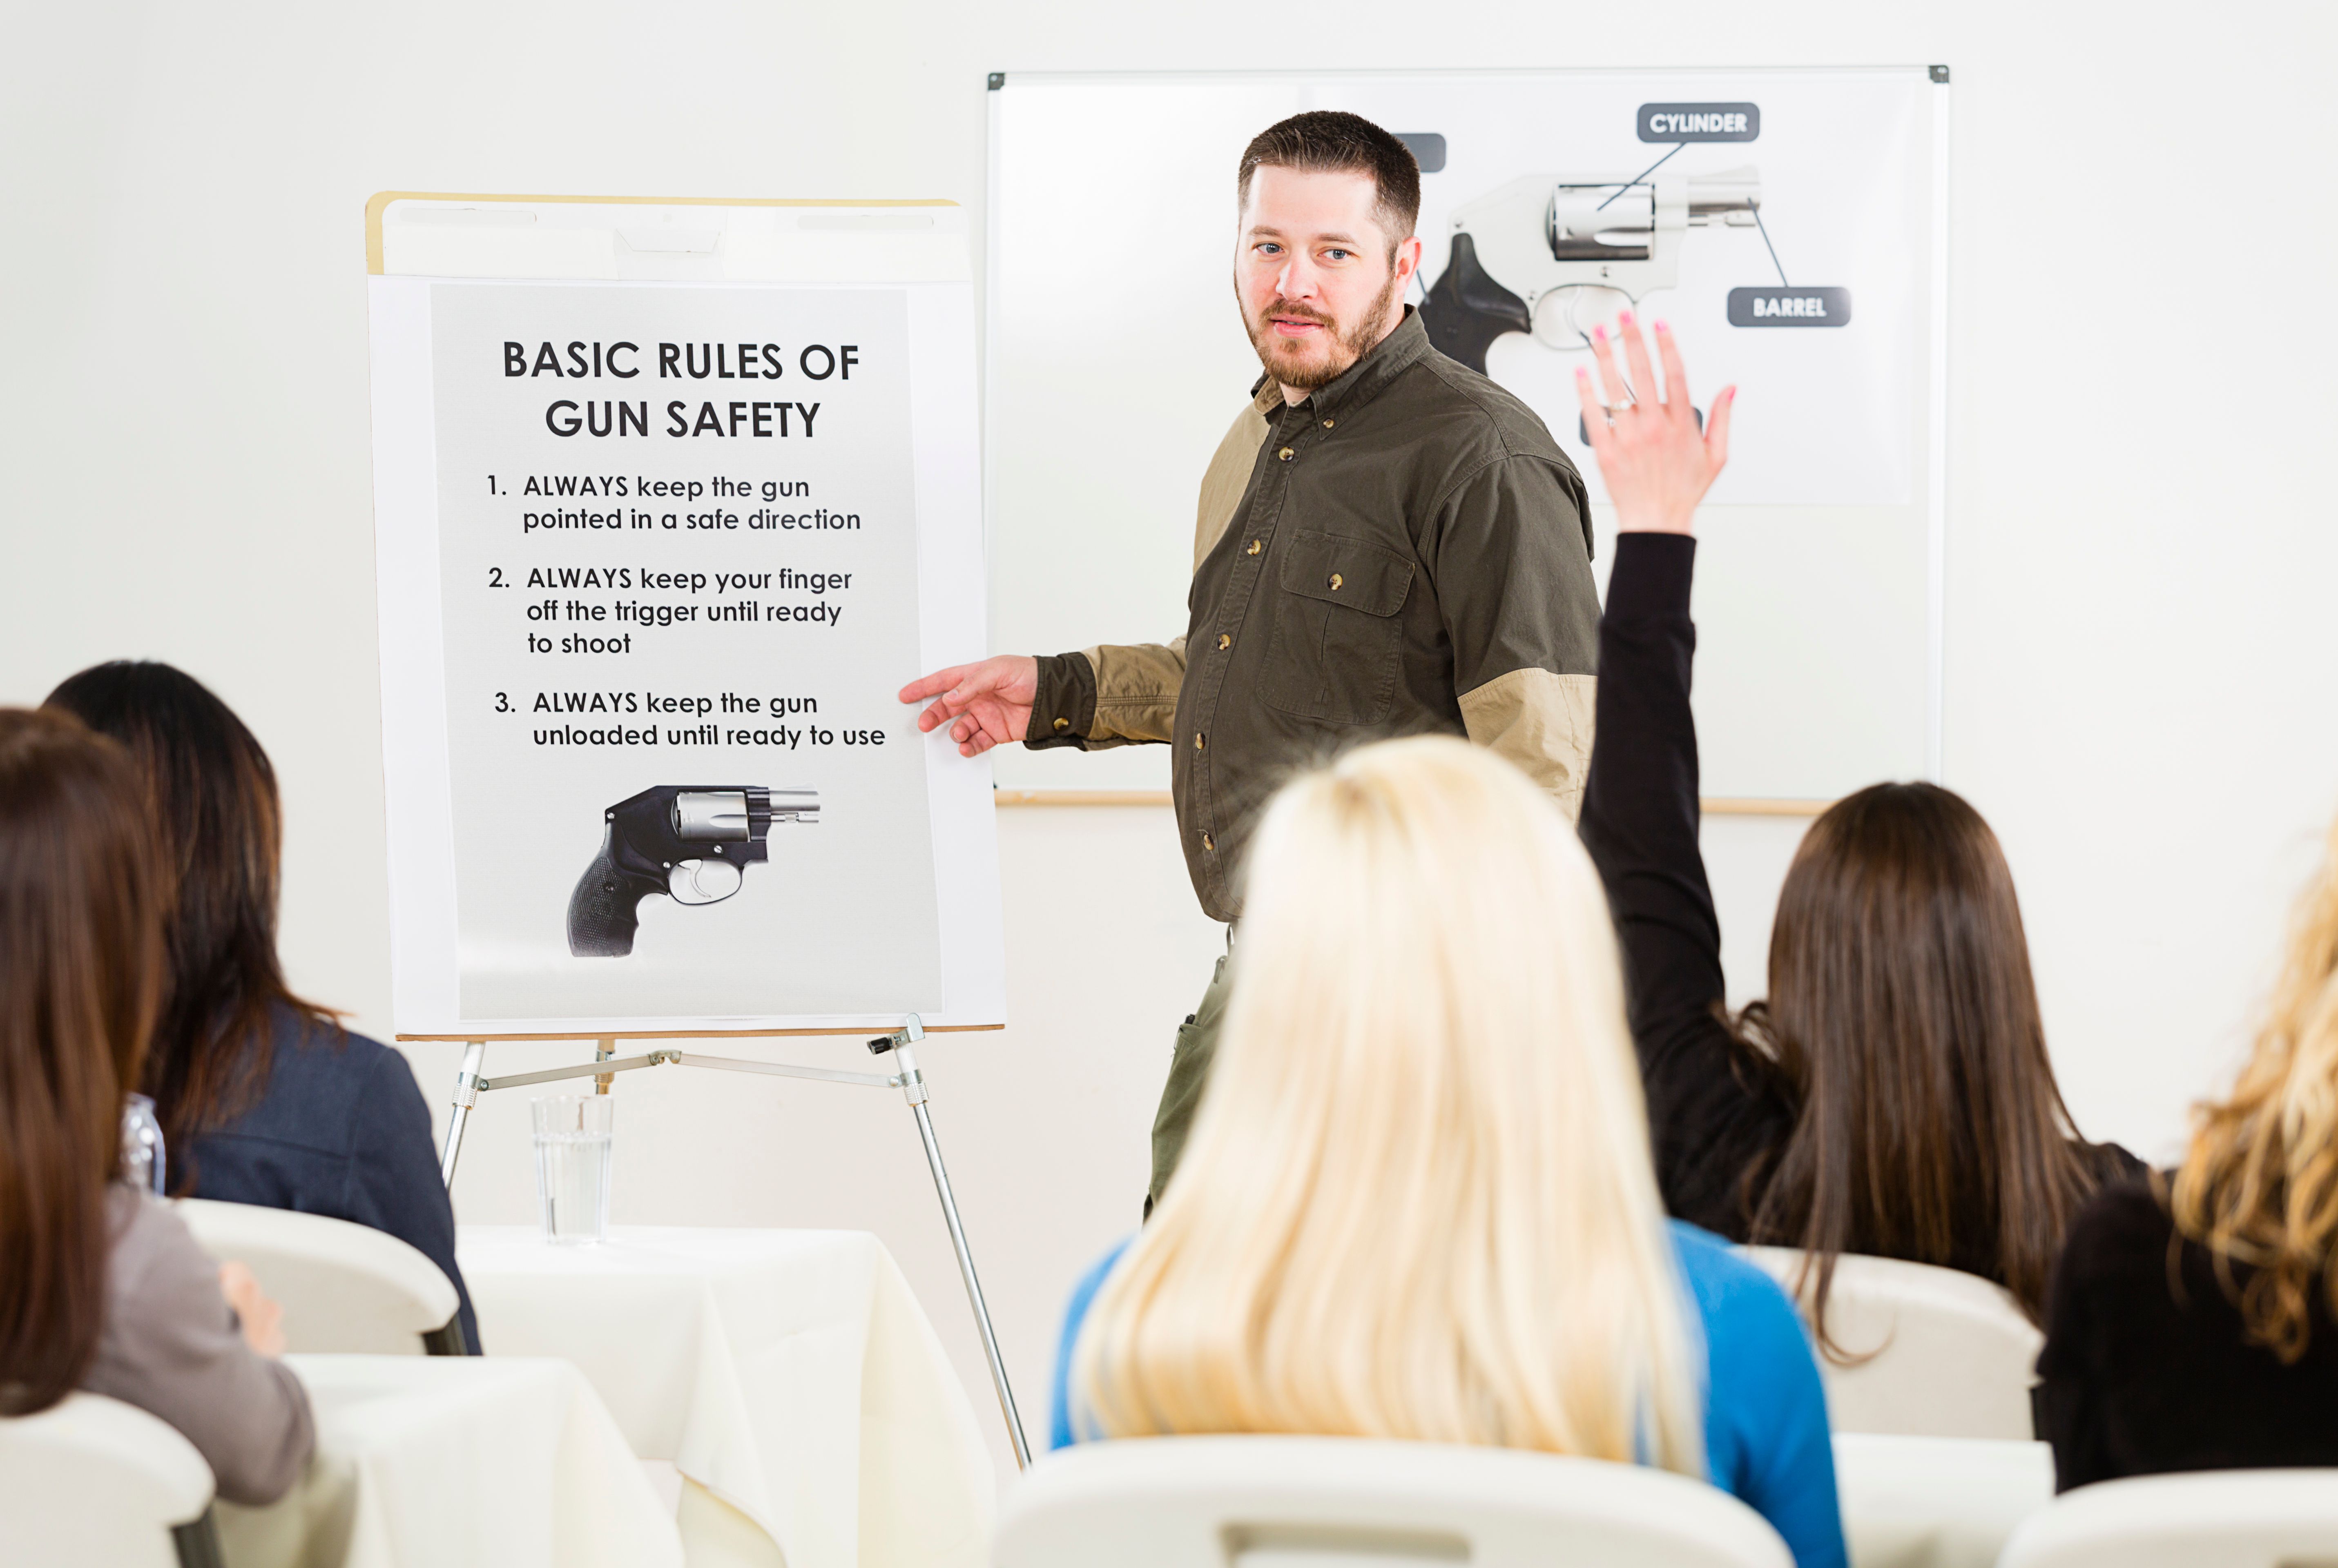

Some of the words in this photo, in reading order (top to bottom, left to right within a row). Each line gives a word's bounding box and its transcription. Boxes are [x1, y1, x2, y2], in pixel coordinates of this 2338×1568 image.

[1649, 113, 1748, 134] CYLINDER
[1753, 297, 1827, 317] BARREL
[504, 341, 640, 379] BASIC
[658, 342, 783, 380] RULES
[799, 344, 859, 381] OF
[545, 399, 648, 438] GUN
[666, 400, 821, 438] SAFETY
[487, 474, 507, 496] 1.
[523, 475, 628, 497] ALWAYS
[637, 476, 703, 502] keep
[712, 476, 752, 497] the
[761, 481, 809, 502] gun
[523, 508, 622, 534] pointed
[630, 508, 652, 529] in
[661, 513, 677, 530] a
[686, 508, 739, 530] safe
[748, 508, 861, 530] direction
[489, 567, 510, 588] 2.
[526, 568, 632, 589] ALWAYS
[640, 568, 707, 594] keep
[714, 573, 772, 594] your
[779, 568, 852, 595] finger
[526, 599, 559, 621] off
[565, 600, 607, 621] the
[614, 600, 699, 627] trigger
[707, 600, 759, 622] until
[767, 601, 842, 627] ready
[527, 632, 553, 654] to
[561, 632, 631, 654] shoot
[495, 691, 516, 713] 3.
[533, 692, 638, 713] ALWAYS
[647, 692, 713, 718] keep
[720, 692, 761, 713] the
[770, 697, 817, 719] gun
[533, 724, 658, 746] unloaded
[667, 724, 719, 746] until
[727, 724, 802, 751] ready
[809, 724, 834, 746] to
[843, 730, 886, 746] use
